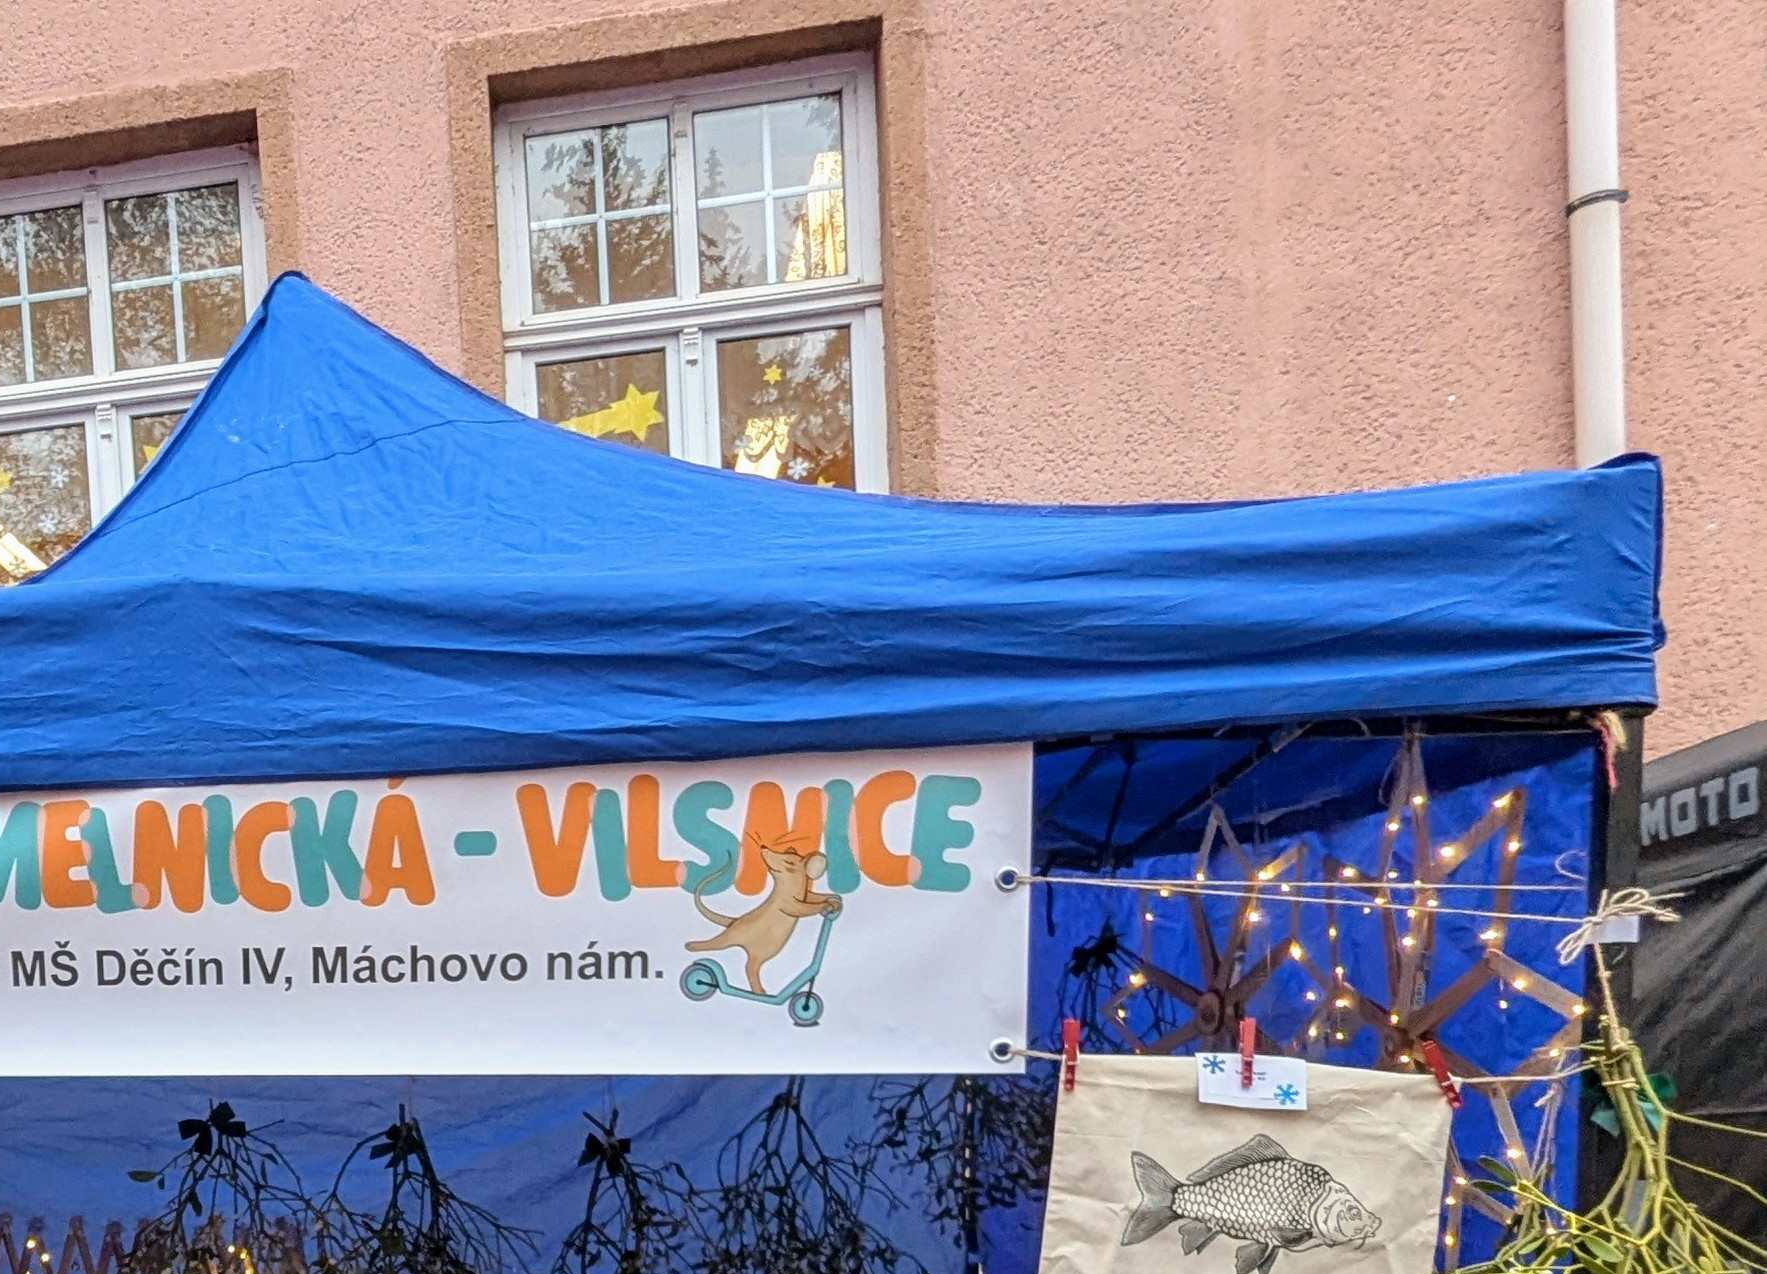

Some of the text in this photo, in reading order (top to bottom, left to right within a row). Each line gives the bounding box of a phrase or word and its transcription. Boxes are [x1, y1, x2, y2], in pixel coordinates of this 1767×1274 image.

[516, 769, 982, 902] VILSNICE
[1640, 766, 1760, 847] MOTO
[10, 940, 79, 987] MŠ
[96, 947, 224, 986] Děčín
[241, 947, 292, 991] IV,
[311, 945, 528, 984] Máchovo
[546, 941, 664, 980] nám.
